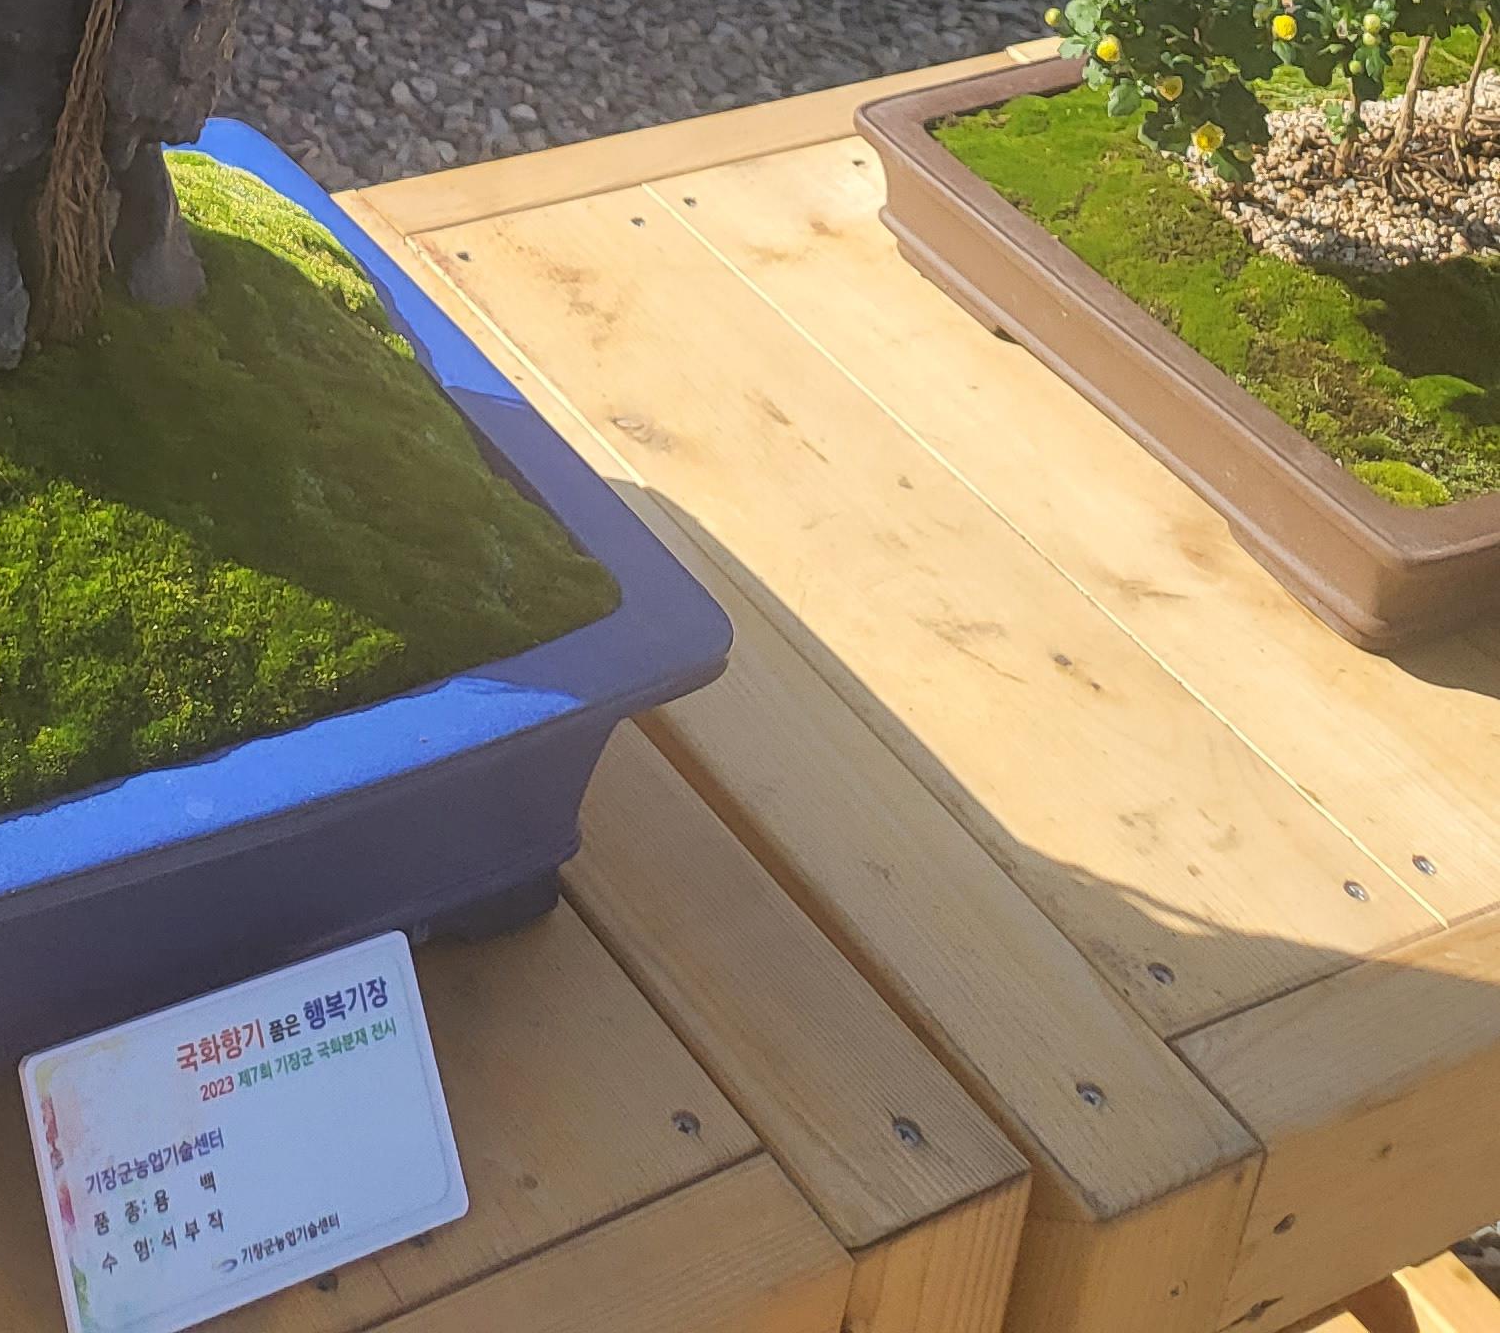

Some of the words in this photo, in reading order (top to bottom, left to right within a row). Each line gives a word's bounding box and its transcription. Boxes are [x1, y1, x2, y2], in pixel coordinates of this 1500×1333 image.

[176, 1019, 265, 1072] 국화향기
[268, 1013, 301, 1044] 품은
[302, 976, 388, 1031] 행복기장
[200, 1075, 235, 1102] 2023
[238, 1060, 273, 1088] 제7회
[274, 1047, 315, 1075] 기장군
[316, 1027, 369, 1060] 국화분재
[370, 1017, 398, 1042] 전시
[84, 1126, 225, 1194] 기장군농업기술센터
[240, 1212, 341, 1265] 기장군농업기술센터
